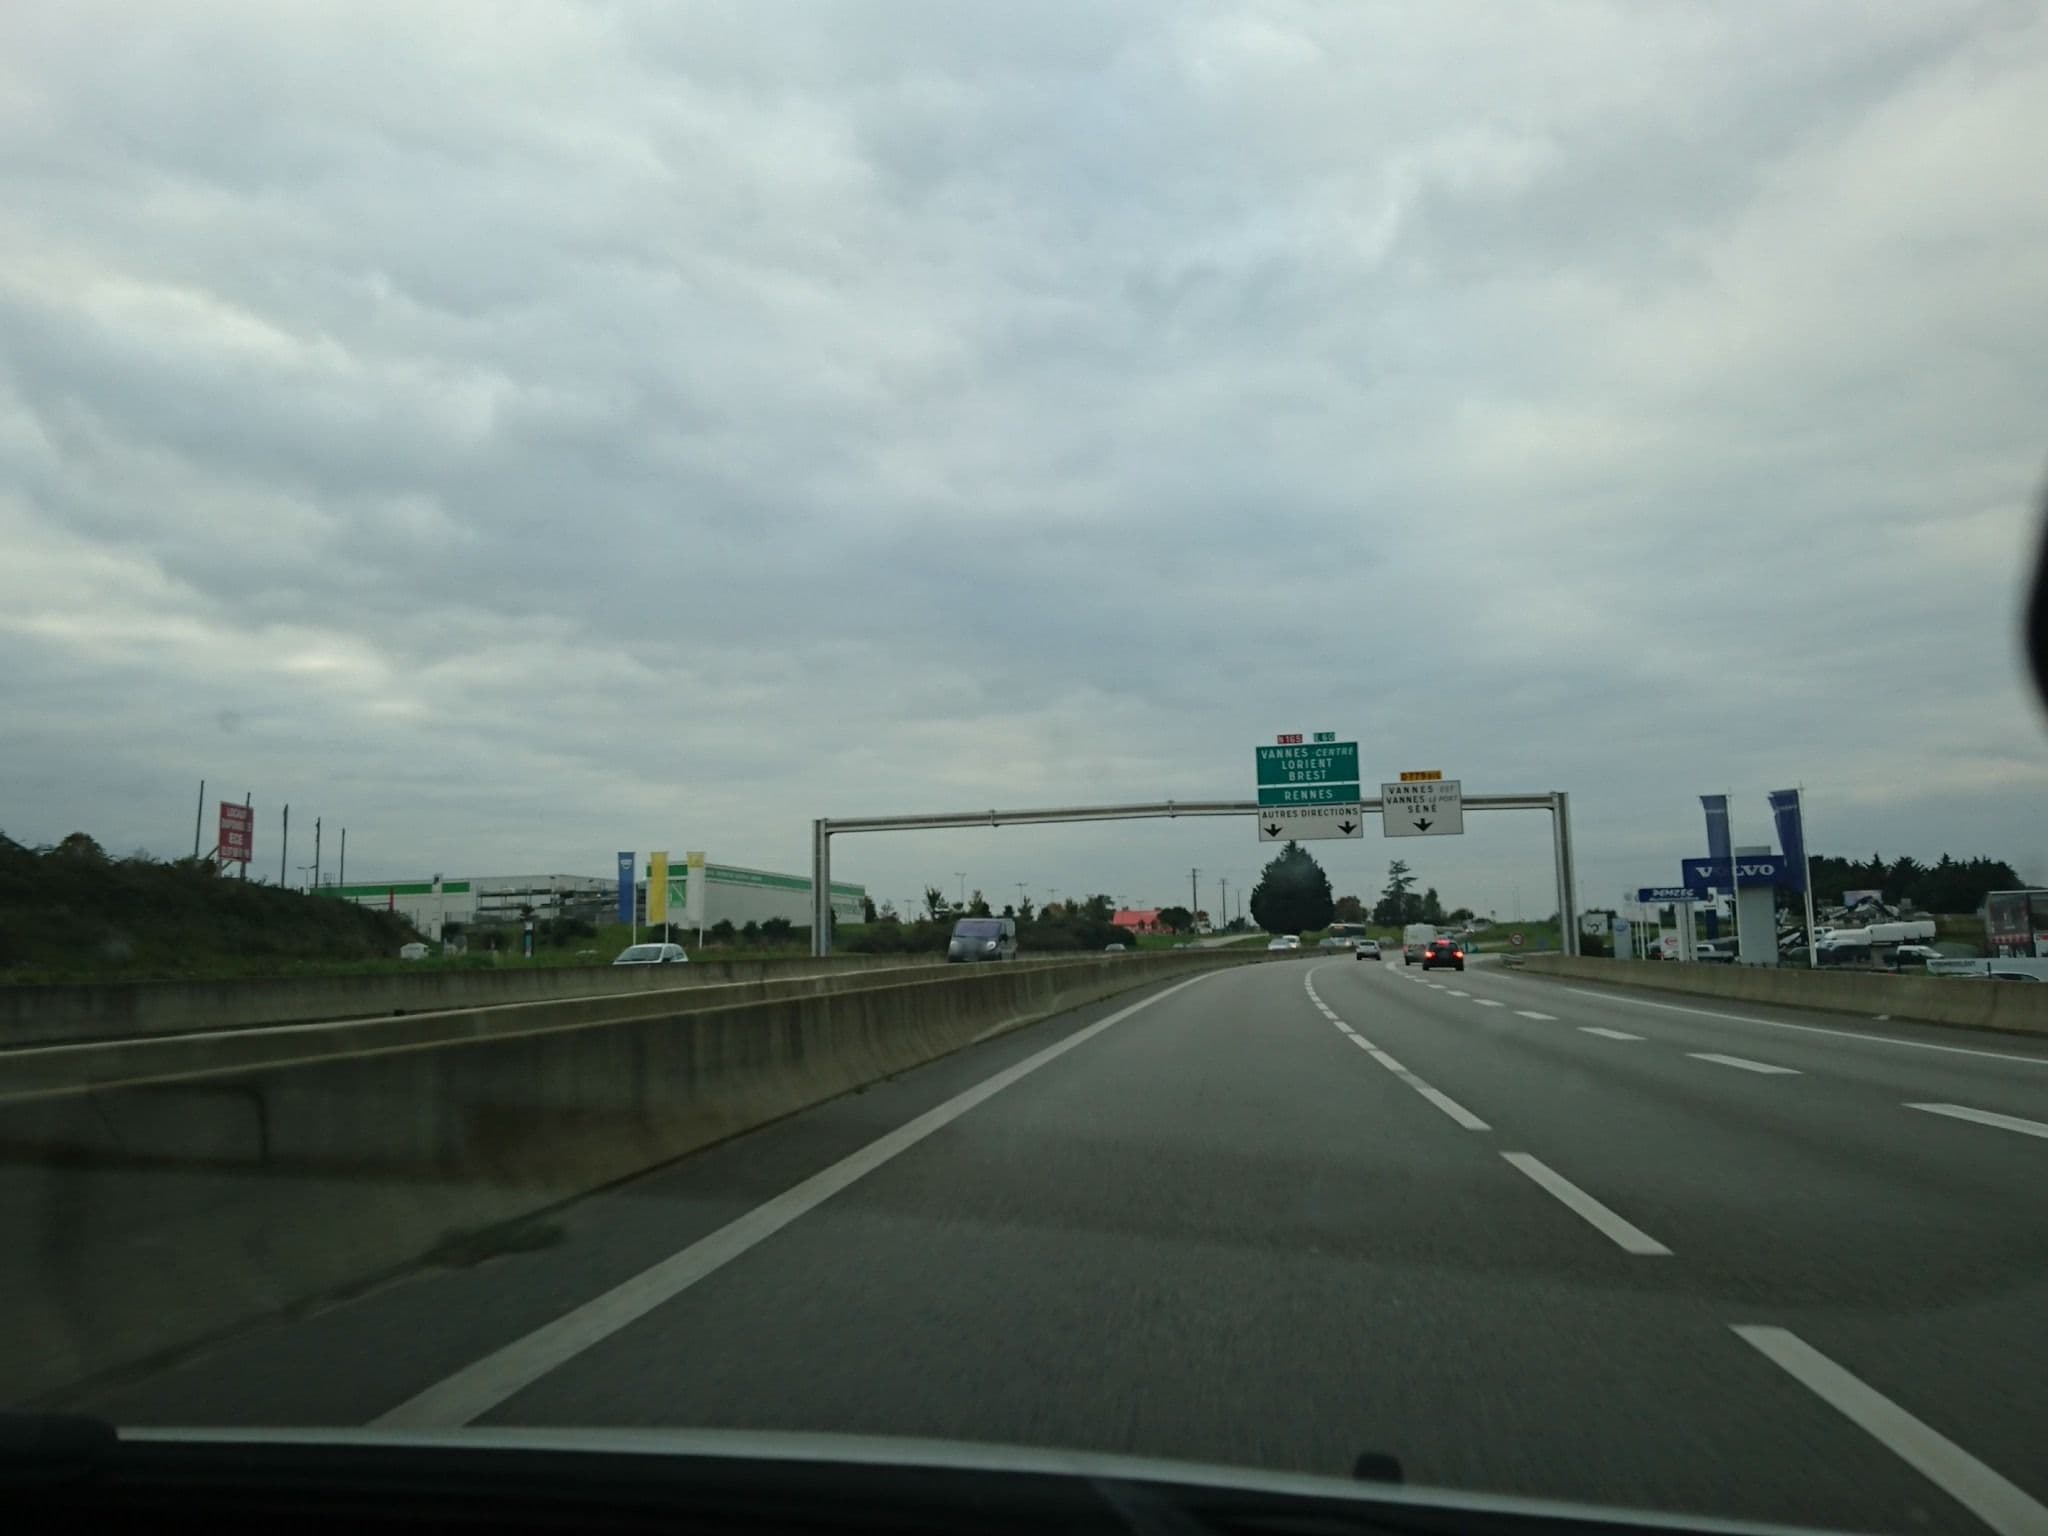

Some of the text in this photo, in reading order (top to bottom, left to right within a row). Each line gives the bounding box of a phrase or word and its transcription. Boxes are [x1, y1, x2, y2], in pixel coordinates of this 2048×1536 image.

[1261, 747, 1309, 759] VANNES
[1281, 758, 1333, 770] LORIENT
[1288, 770, 1327, 781] BREST
[1284, 789, 1333, 801] RENNES
[1389, 785, 1434, 795] VANNES
[1387, 795, 1425, 805] VANNES
[1262, 807, 1358, 818] AUTRES DIRECTIONS
